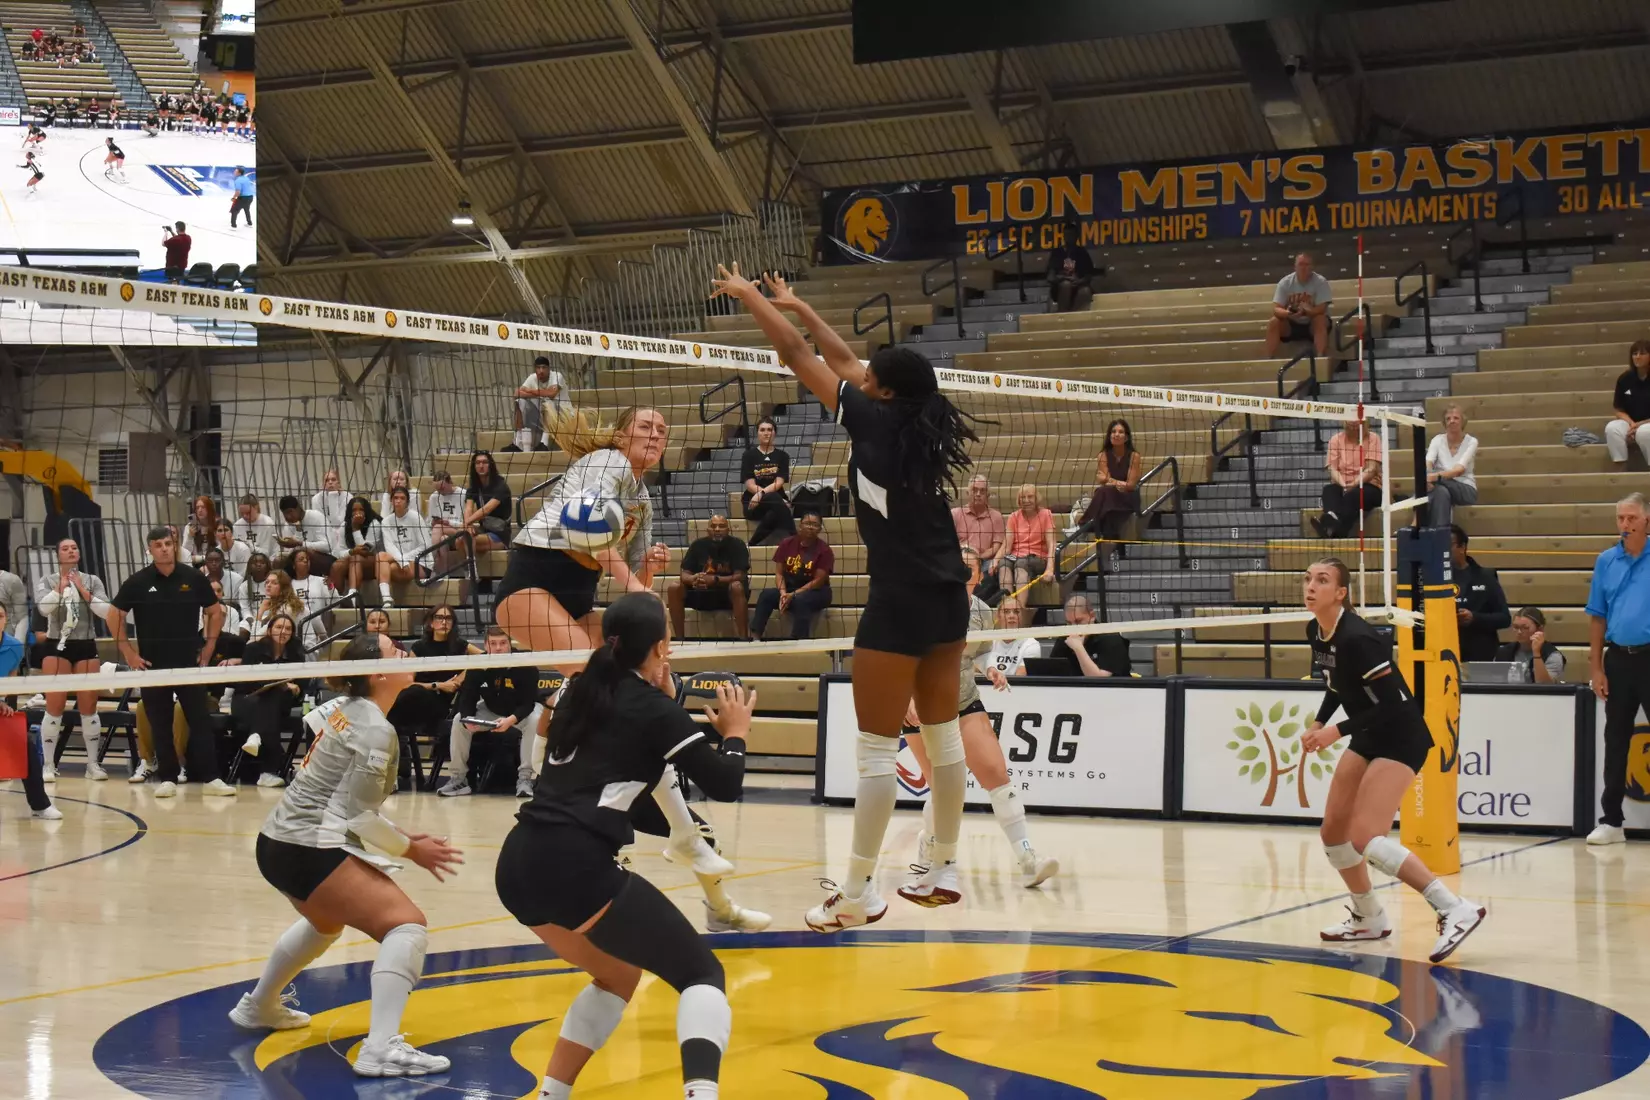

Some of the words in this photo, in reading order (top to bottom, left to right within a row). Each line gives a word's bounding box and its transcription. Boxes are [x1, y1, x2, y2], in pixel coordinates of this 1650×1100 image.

[952, 174, 1093, 225] LION
[1118, 155, 1327, 212] MEN'S
[1558, 184, 1589, 213] 30
[1240, 210, 1252, 236] 7
[1260, 205, 1320, 235] NCAA
[1327, 192, 1498, 230] TOURNAMENTS
[1040, 214, 1208, 249] CHMPIONSHIPS
[0, 271, 28, 287] AST
[32, 275, 76, 293] TEXAS
[81, 281, 108, 296] A&M
[146, 288, 177, 304] EAST
[182, 292, 220, 308] TEXAS
[224, 297, 249, 311] A&M
[284, 302, 311, 317] EAST
[315, 306, 349, 321] TEXAS
[353, 310, 376, 324] A&M
[406, 316, 432, 330] EAST
[435, 318, 466, 334] TEXAS
[470, 323, 489, 336] A&M
[516, 328, 540, 340] EAST
[543, 330, 572, 344] TEXAS
[574, 334, 592, 346] A&M
[616, 339, 638, 350] EAST
[640, 341, 667, 354] TEXAS
[669, 344, 687, 355] A&M
[708, 348, 728, 359] EAST
[730, 350, 754, 362] TEXAS
[757, 354, 772, 364] A&M
[940, 372, 956, 382] EAST
[957, 374, 976, 384] TEXAS
[1006, 378, 1020, 388] EAST
[1022, 380, 1039, 390] TEXAS
[1067, 383, 1080, 393] EAST
[1082, 384, 1098, 394] TEXAS
[443, 502, 455, 514] ET
[246, 531, 257, 542] ET
[397, 526, 408, 538] ET
[296, 588, 309, 599] ET
[538, 679, 562, 688] ONS
[1458, 740, 1491, 776] al
[1006, 768, 1075, 778] SYSTEMS
